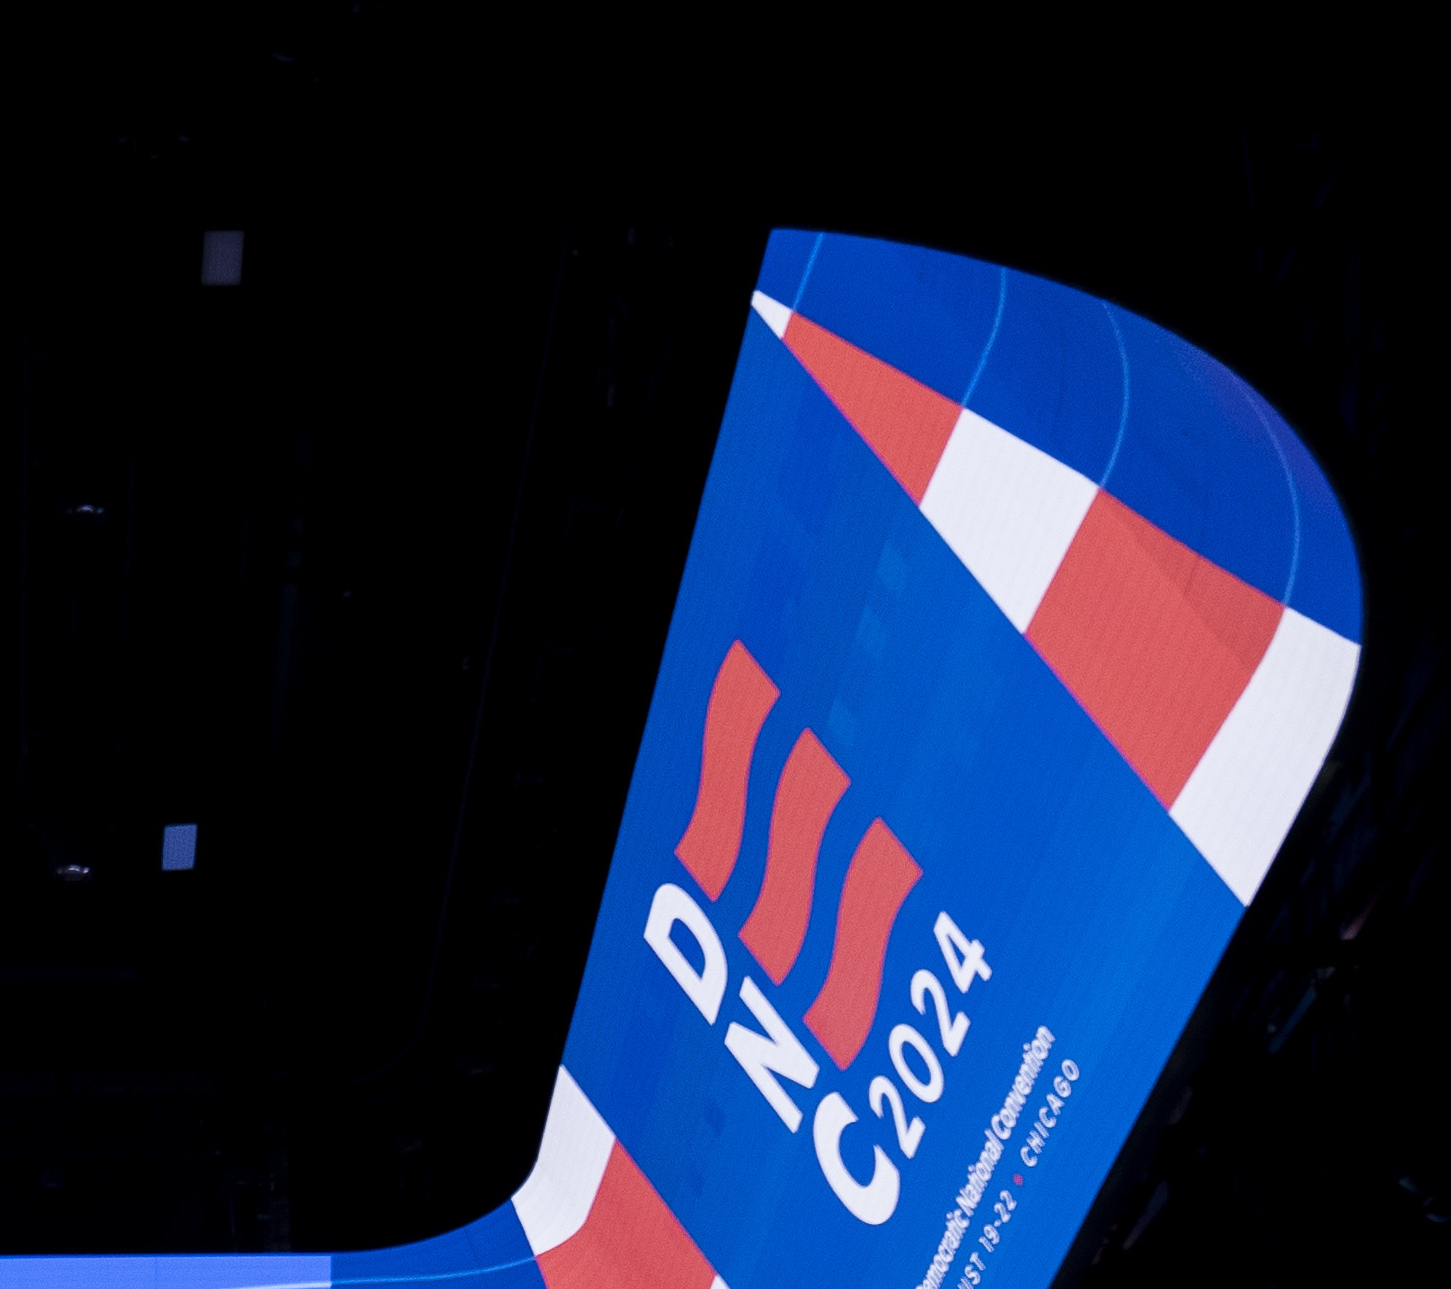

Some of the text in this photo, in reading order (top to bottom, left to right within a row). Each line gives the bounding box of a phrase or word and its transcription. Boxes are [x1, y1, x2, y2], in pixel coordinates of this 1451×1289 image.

[643, 883, 900, 1225] DNC
[868, 910, 992, 1159] 2024
[955, 1127, 1005, 1218] National
[990, 1024, 1056, 1140] Convention
[978, 1189, 1017, 1253] 19-22
[1019, 1058, 1081, 1167] CHICAGO
